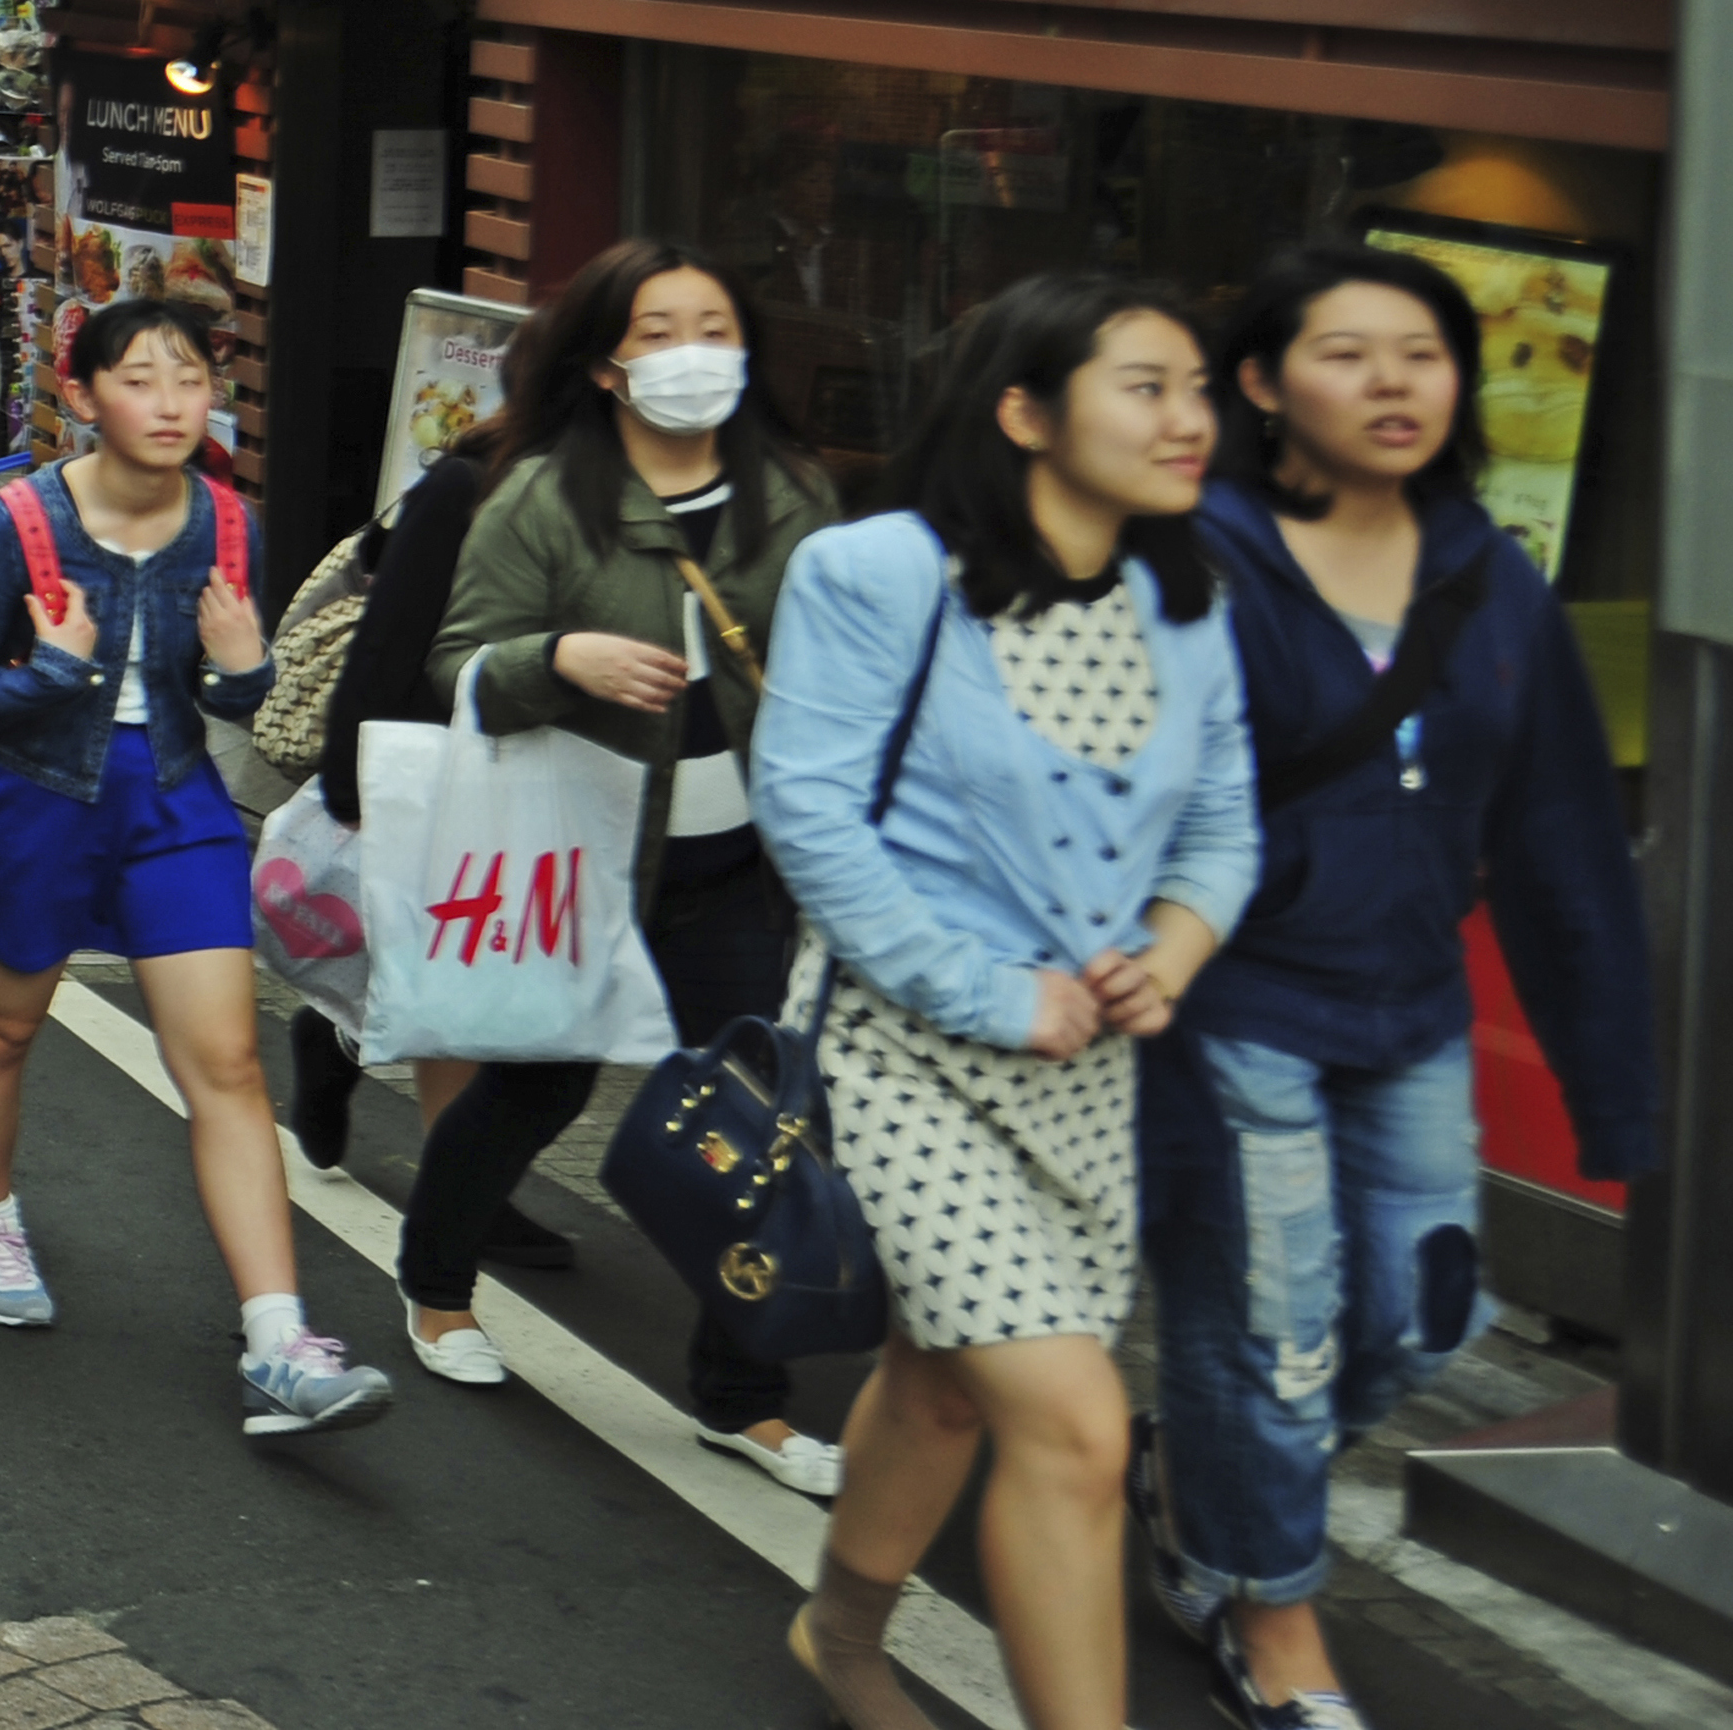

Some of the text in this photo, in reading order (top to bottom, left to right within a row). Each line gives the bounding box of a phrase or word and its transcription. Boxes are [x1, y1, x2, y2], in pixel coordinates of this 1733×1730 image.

[86, 98, 213, 140] LUNCH MENU
[428, 847, 583, 966] H&M
